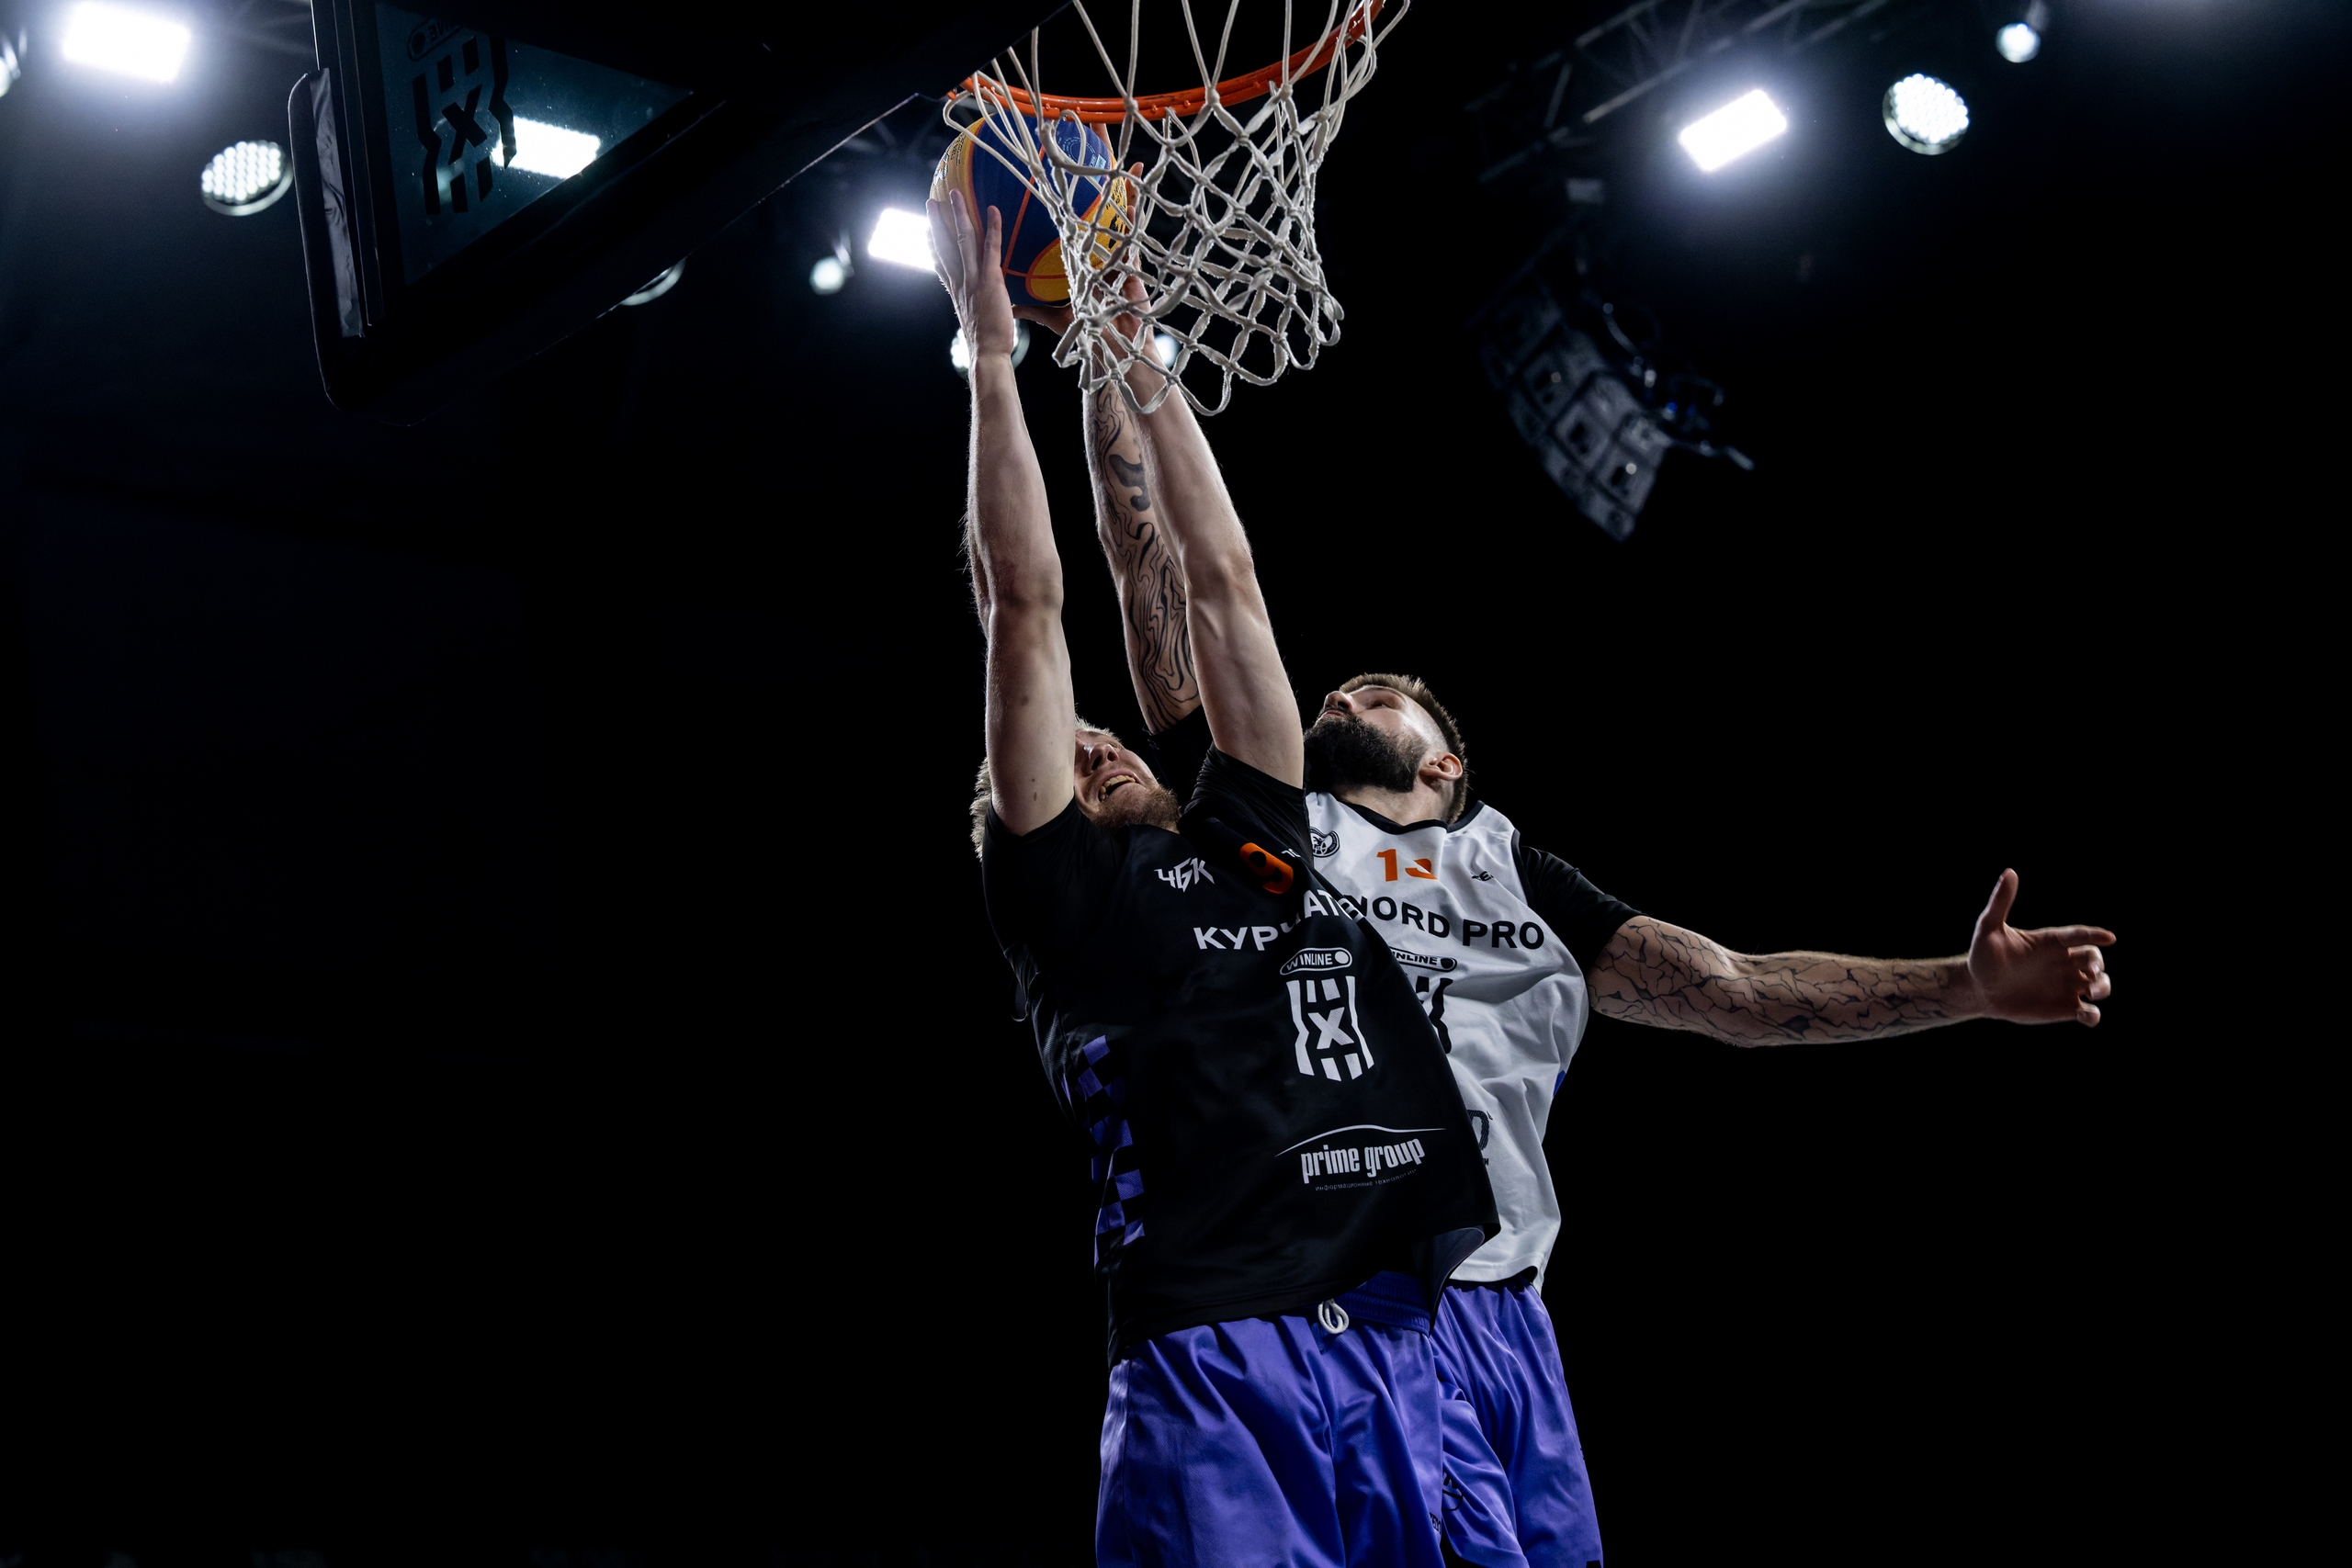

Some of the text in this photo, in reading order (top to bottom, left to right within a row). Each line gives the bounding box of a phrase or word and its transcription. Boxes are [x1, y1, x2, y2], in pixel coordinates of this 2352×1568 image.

[1239, 841, 1295, 895] 9
[1462, 919, 1544, 950] PRO
[1286, 953, 1333, 971] WINLINE
[1301, 1138, 1426, 1184] prime group
